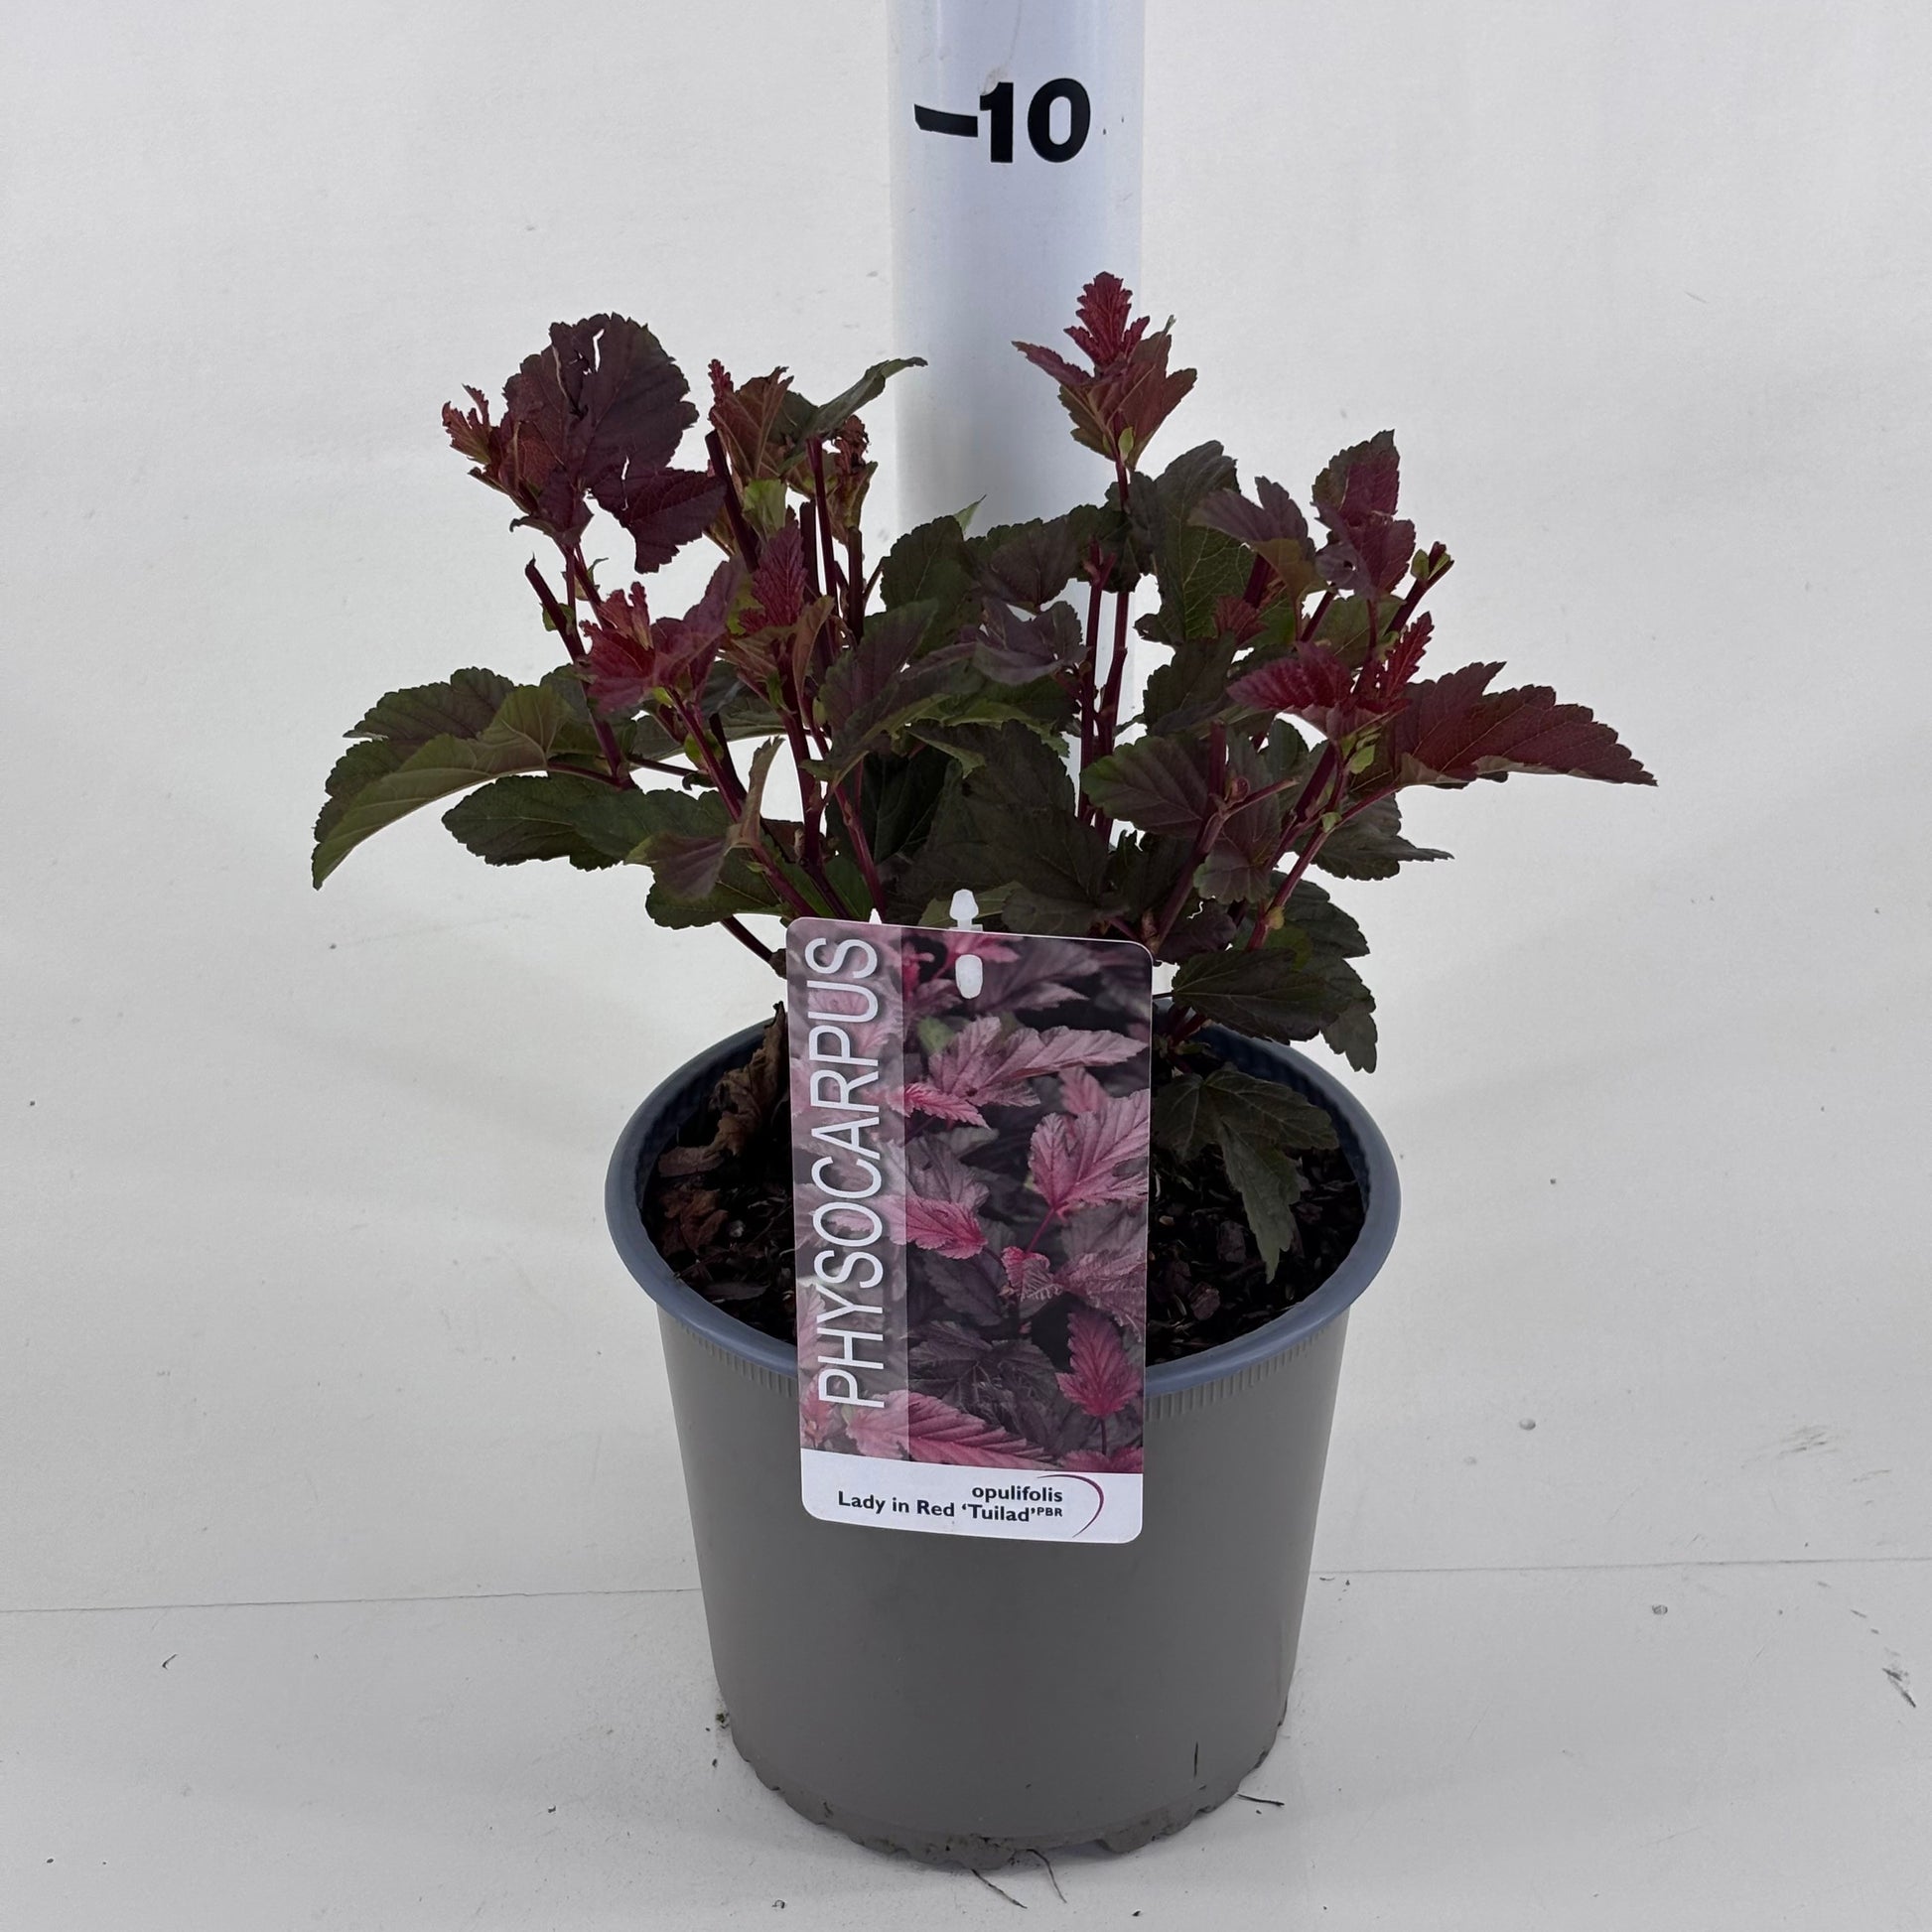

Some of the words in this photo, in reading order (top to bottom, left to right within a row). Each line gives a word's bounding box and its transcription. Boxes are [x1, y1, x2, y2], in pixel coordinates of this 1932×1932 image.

[804, 937, 885, 1409] PHYSOCARPUS
[838, 1490, 886, 1514] Lady
[892, 1496, 909, 1513] in
[916, 1499, 955, 1517] Red
[971, 1484, 1063, 1502] opulifolis
